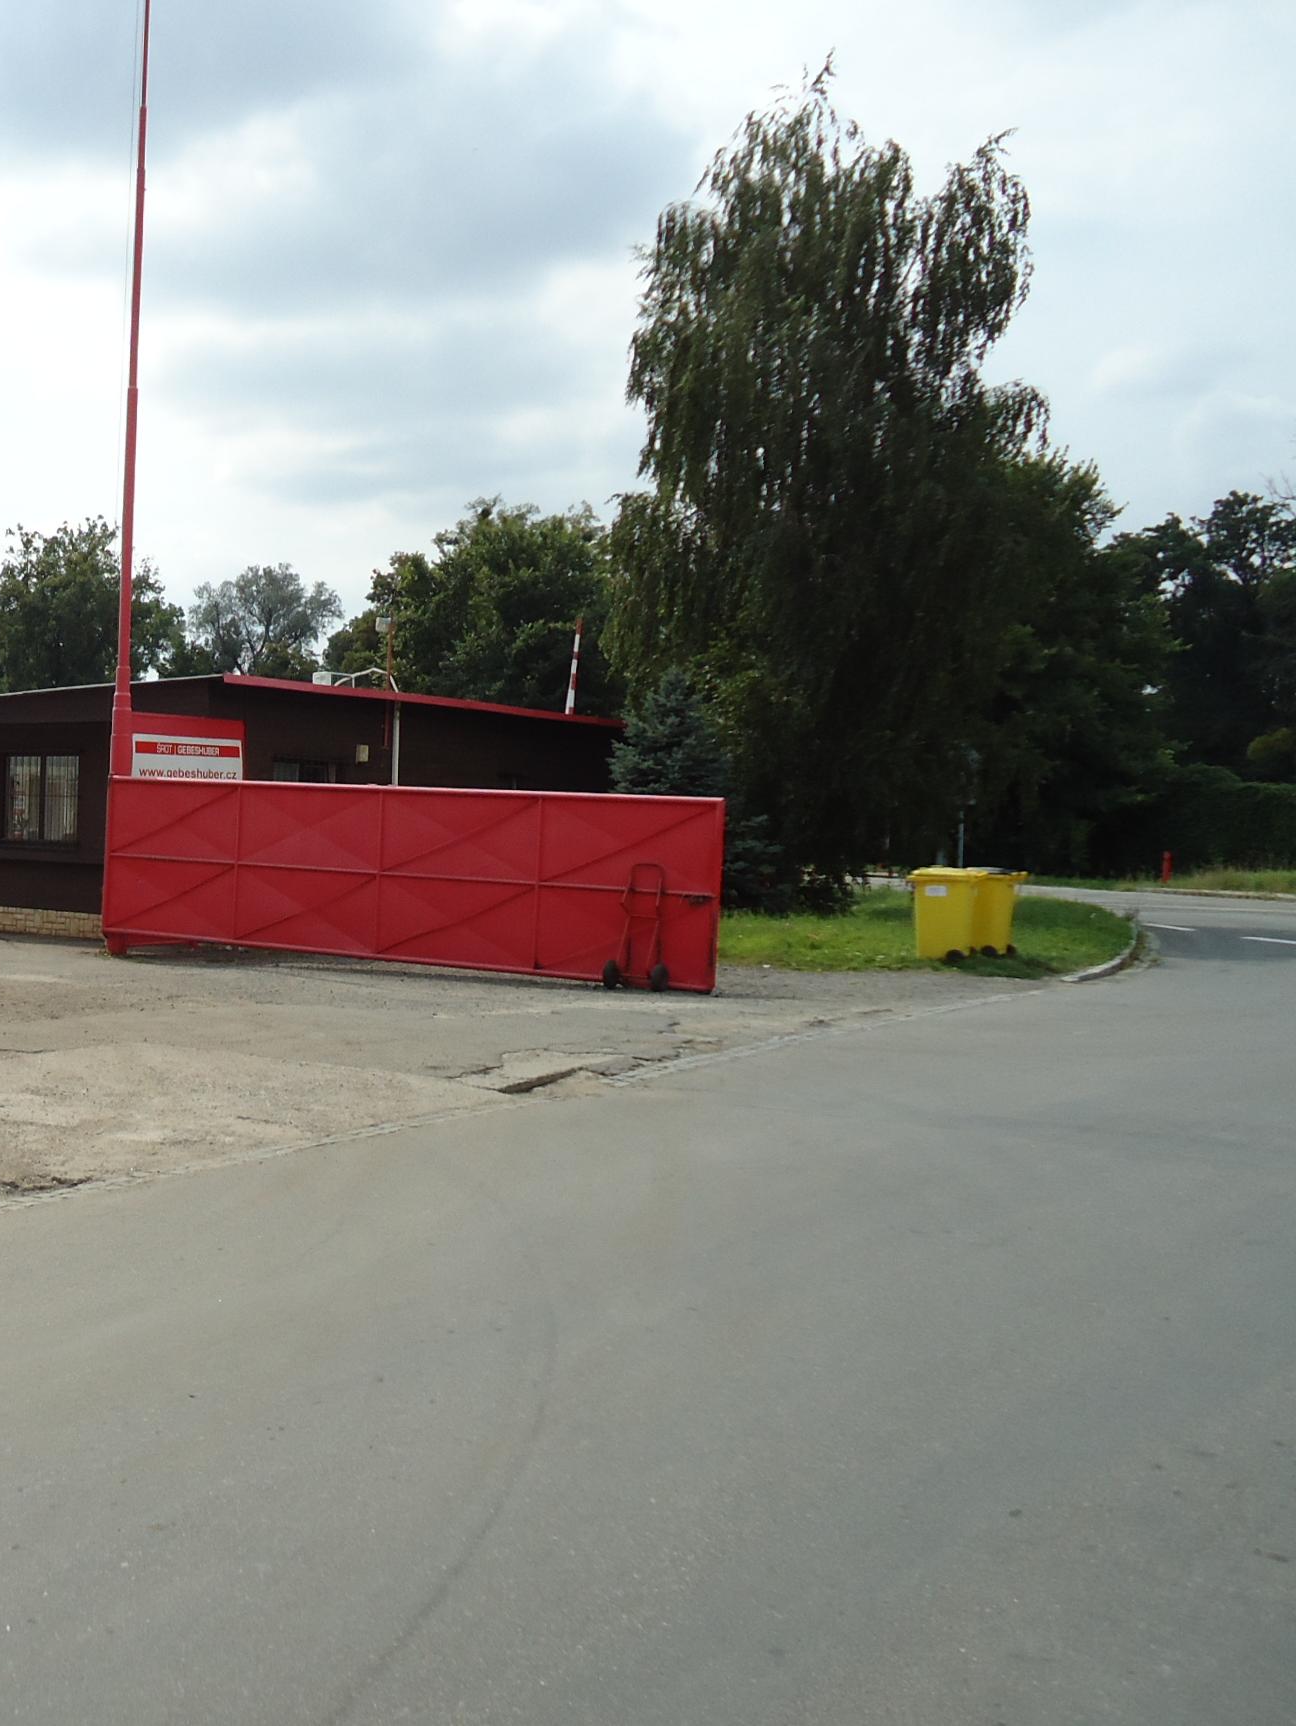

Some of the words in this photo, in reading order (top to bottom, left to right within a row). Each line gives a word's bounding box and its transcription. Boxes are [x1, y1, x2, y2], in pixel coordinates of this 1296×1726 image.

[156, 743, 172, 754] ŠROT
[177, 745, 220, 757] GEBESHUBER
[138, 767, 237, 780] www.gebeshuber.cz
